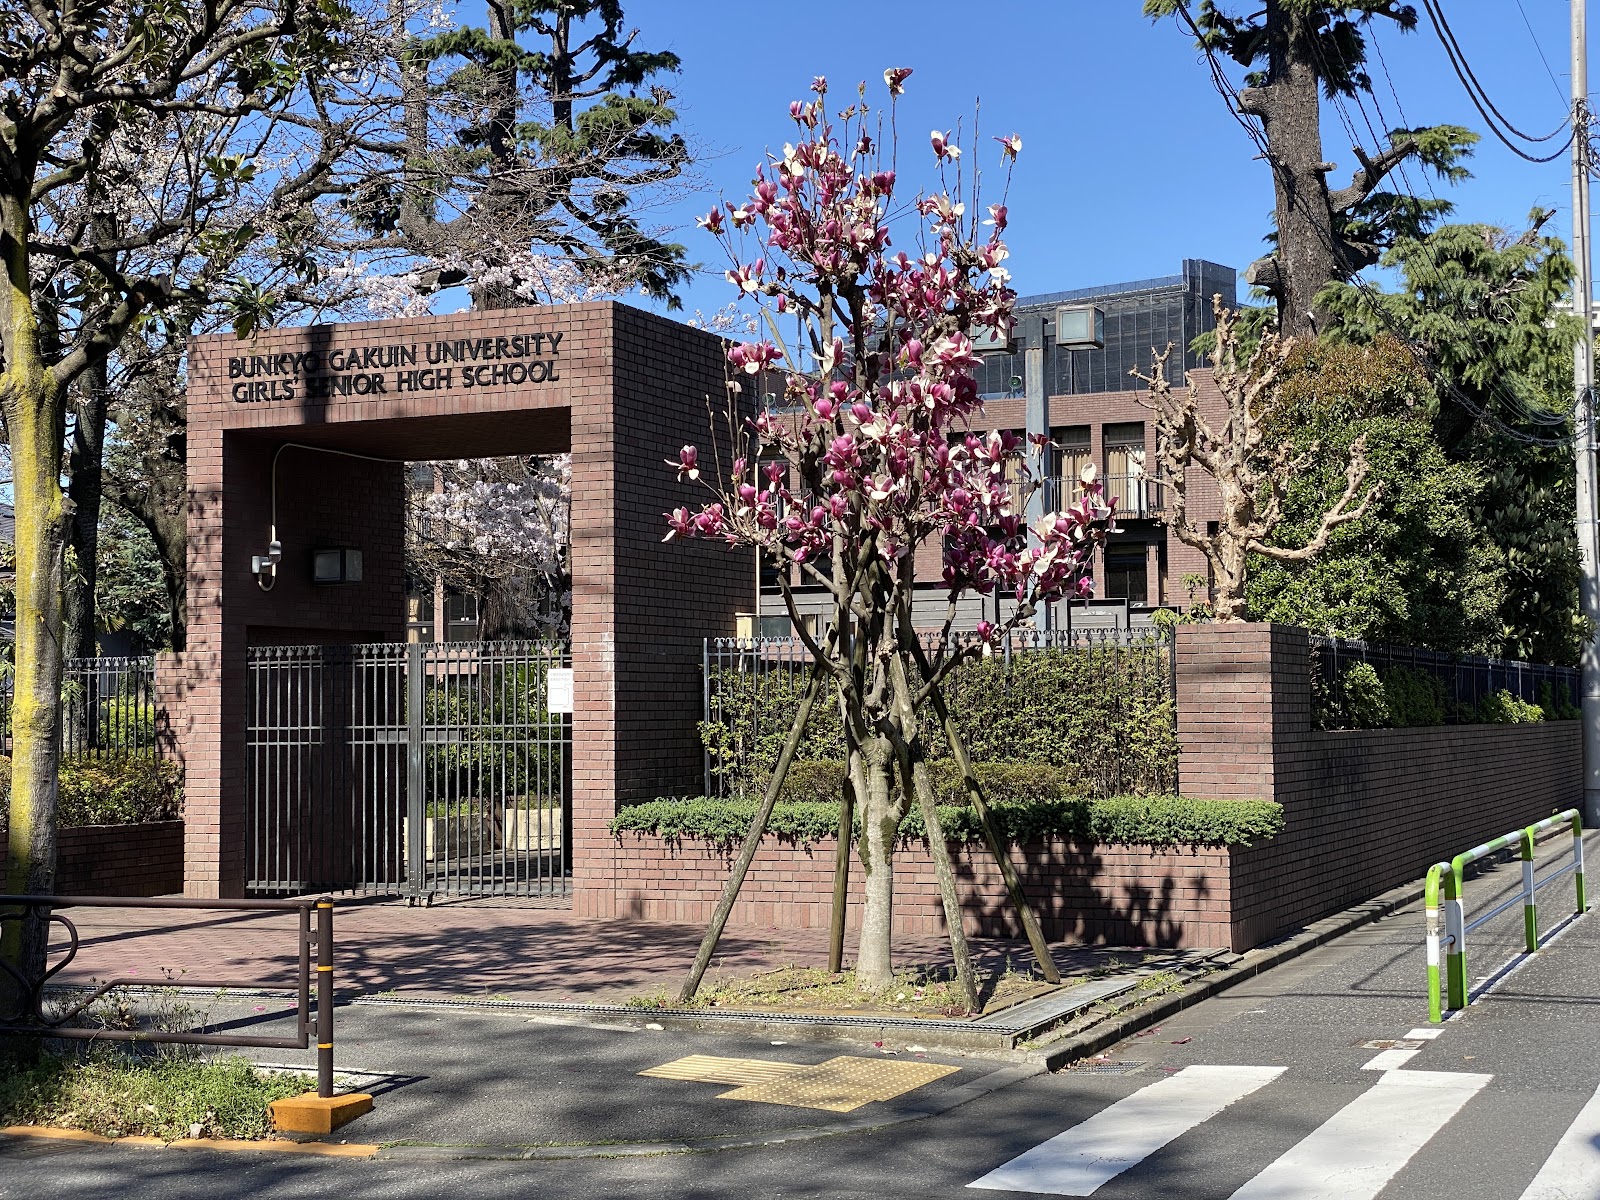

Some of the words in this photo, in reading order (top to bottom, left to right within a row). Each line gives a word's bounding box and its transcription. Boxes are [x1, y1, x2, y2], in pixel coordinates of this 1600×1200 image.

[229, 352, 319, 378] BUNKYO
[329, 344, 416, 372] GAKUIN
[426, 332, 563, 364] UNIVERSITY
[232, 378, 298, 403] GIRLS'
[305, 373, 387, 398] SENIOR
[397, 368, 453, 392] HIGH
[462, 360, 559, 387] SCHOOL
